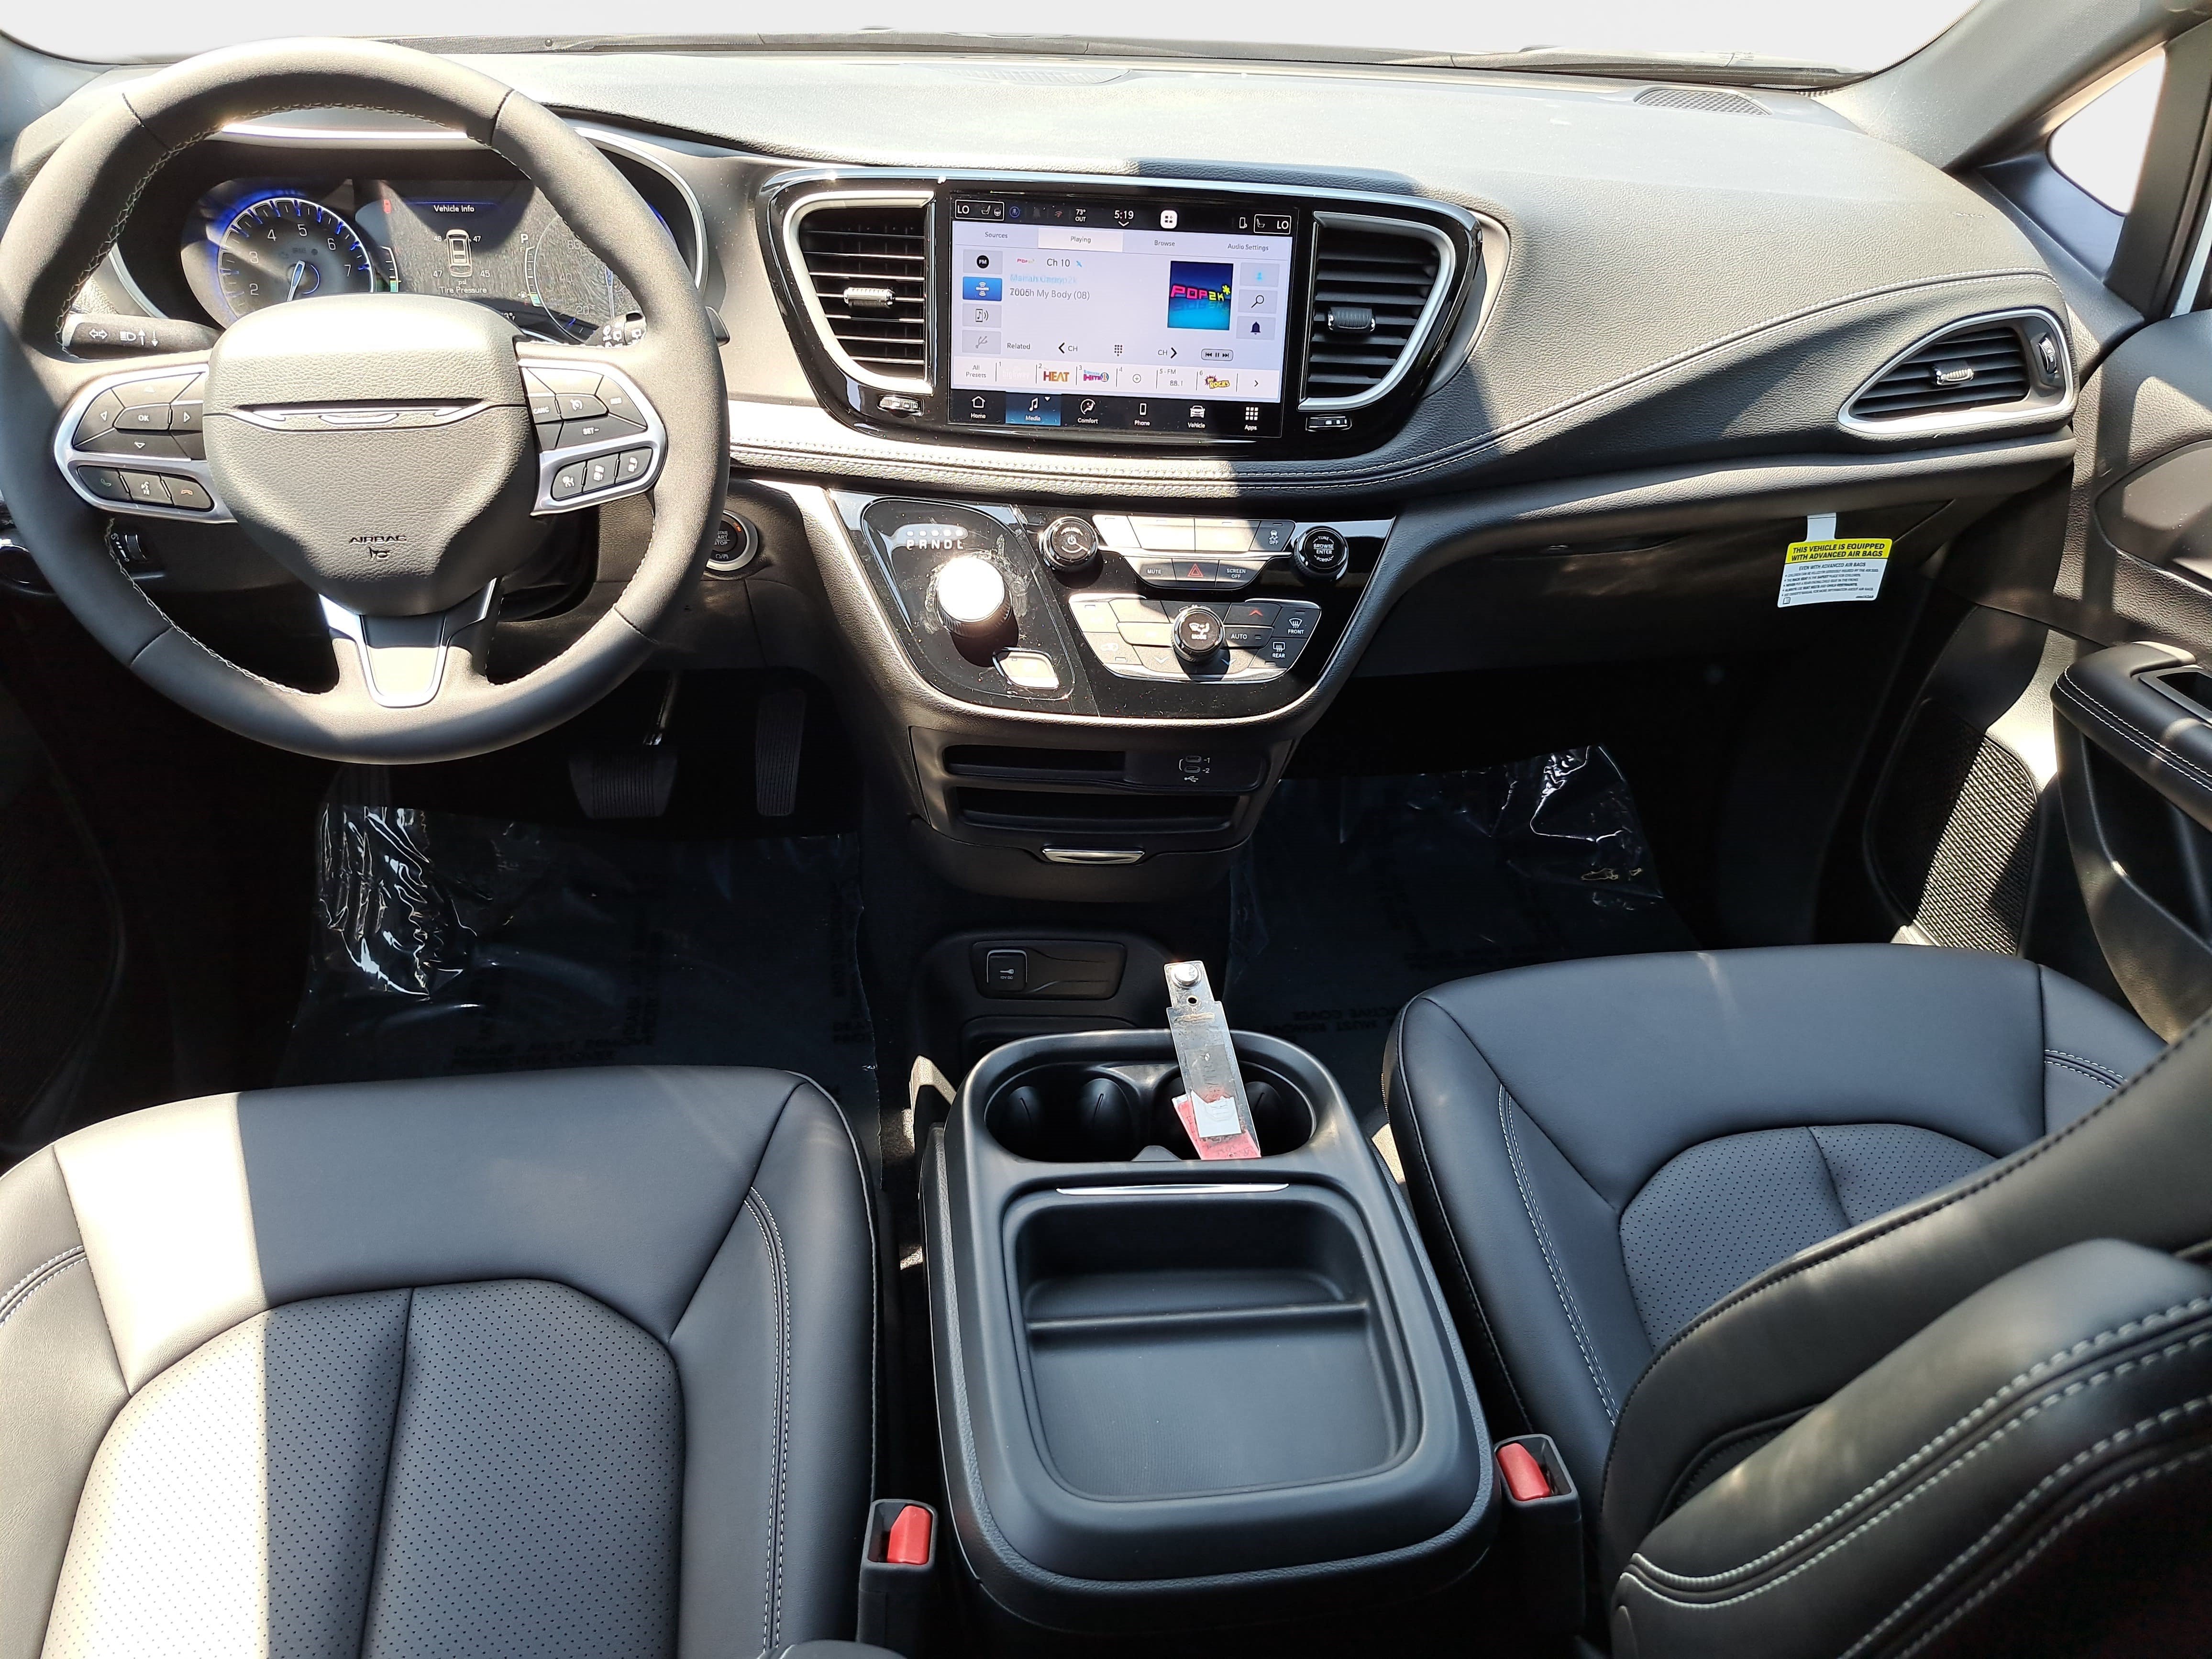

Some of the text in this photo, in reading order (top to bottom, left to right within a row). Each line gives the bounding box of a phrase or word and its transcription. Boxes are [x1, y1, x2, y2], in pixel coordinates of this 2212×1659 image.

[957, 205, 970, 214] LO
[1114, 210, 1134, 220] 5:19
[1277, 220, 1289, 229] LO
[267, 229, 277, 241] 4
[298, 224, 308, 237] 5
[327, 238, 336, 250] 6
[520, 234, 529, 243] P
[249, 251, 259, 264] 3
[1047, 258, 1058, 266] Ch
[344, 264, 351, 277] 7
[249, 283, 259, 296] 2
[1037, 289, 1049, 299] My
[1051, 290, 1072, 299] Body
[1074, 291, 1090, 300] (08)
[576, 306, 589, 314] 20
[1043, 371, 1070, 382] HEAT
[907, 540, 914, 550] P
[919, 540, 927, 549] R
[931, 540, 940, 549] N
[944, 540, 952, 549] D
